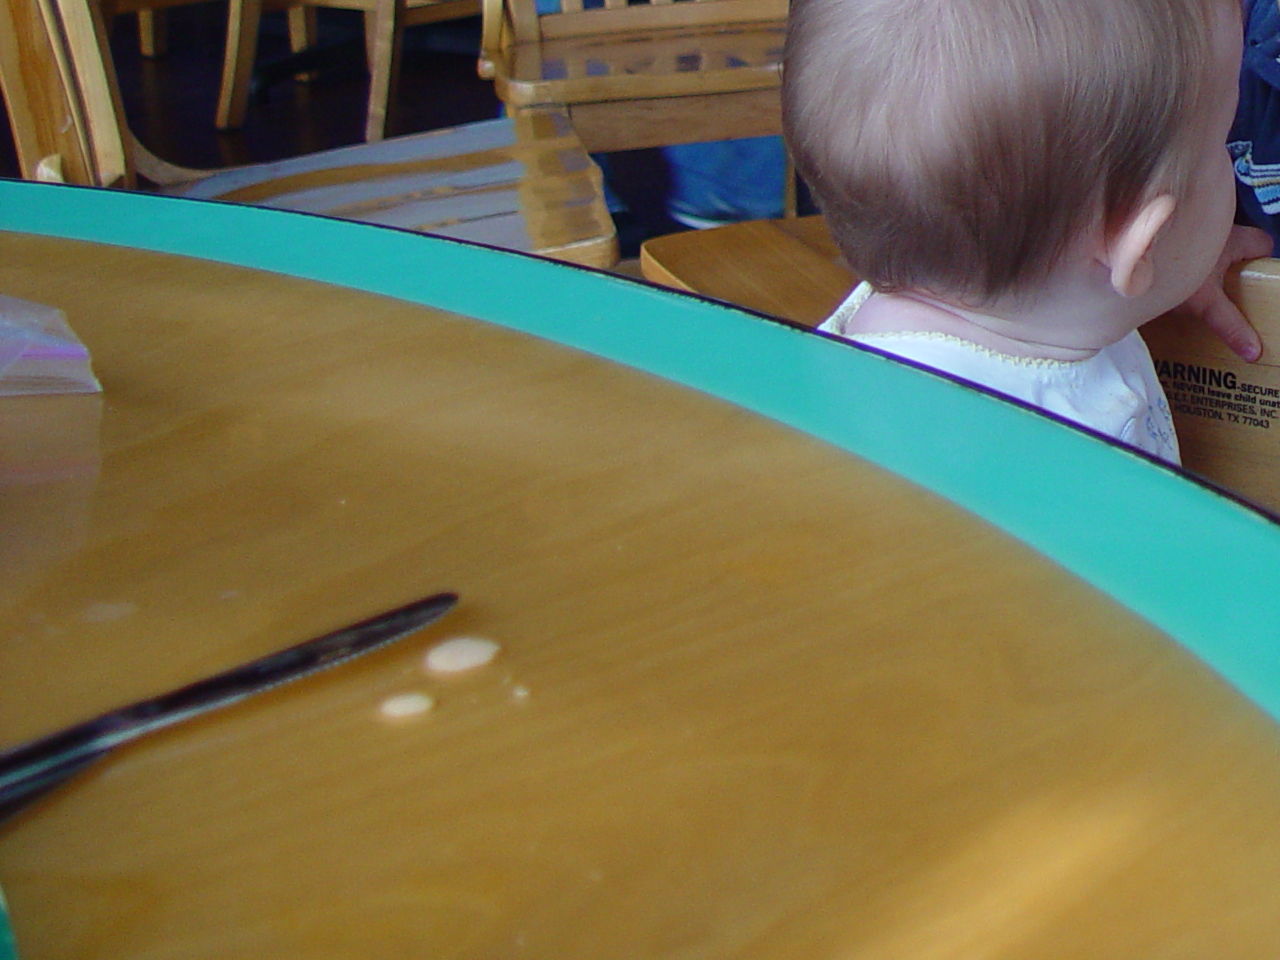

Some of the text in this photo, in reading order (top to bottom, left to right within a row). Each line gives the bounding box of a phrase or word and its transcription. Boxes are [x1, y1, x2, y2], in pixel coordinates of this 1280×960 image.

[1173, 381, 1205, 395] NEVER
[1207, 388, 1232, 399] leave
[1234, 393, 1257, 404] child
[1227, 412, 1240, 424] TX
[1242, 415, 1270, 428] 77043
